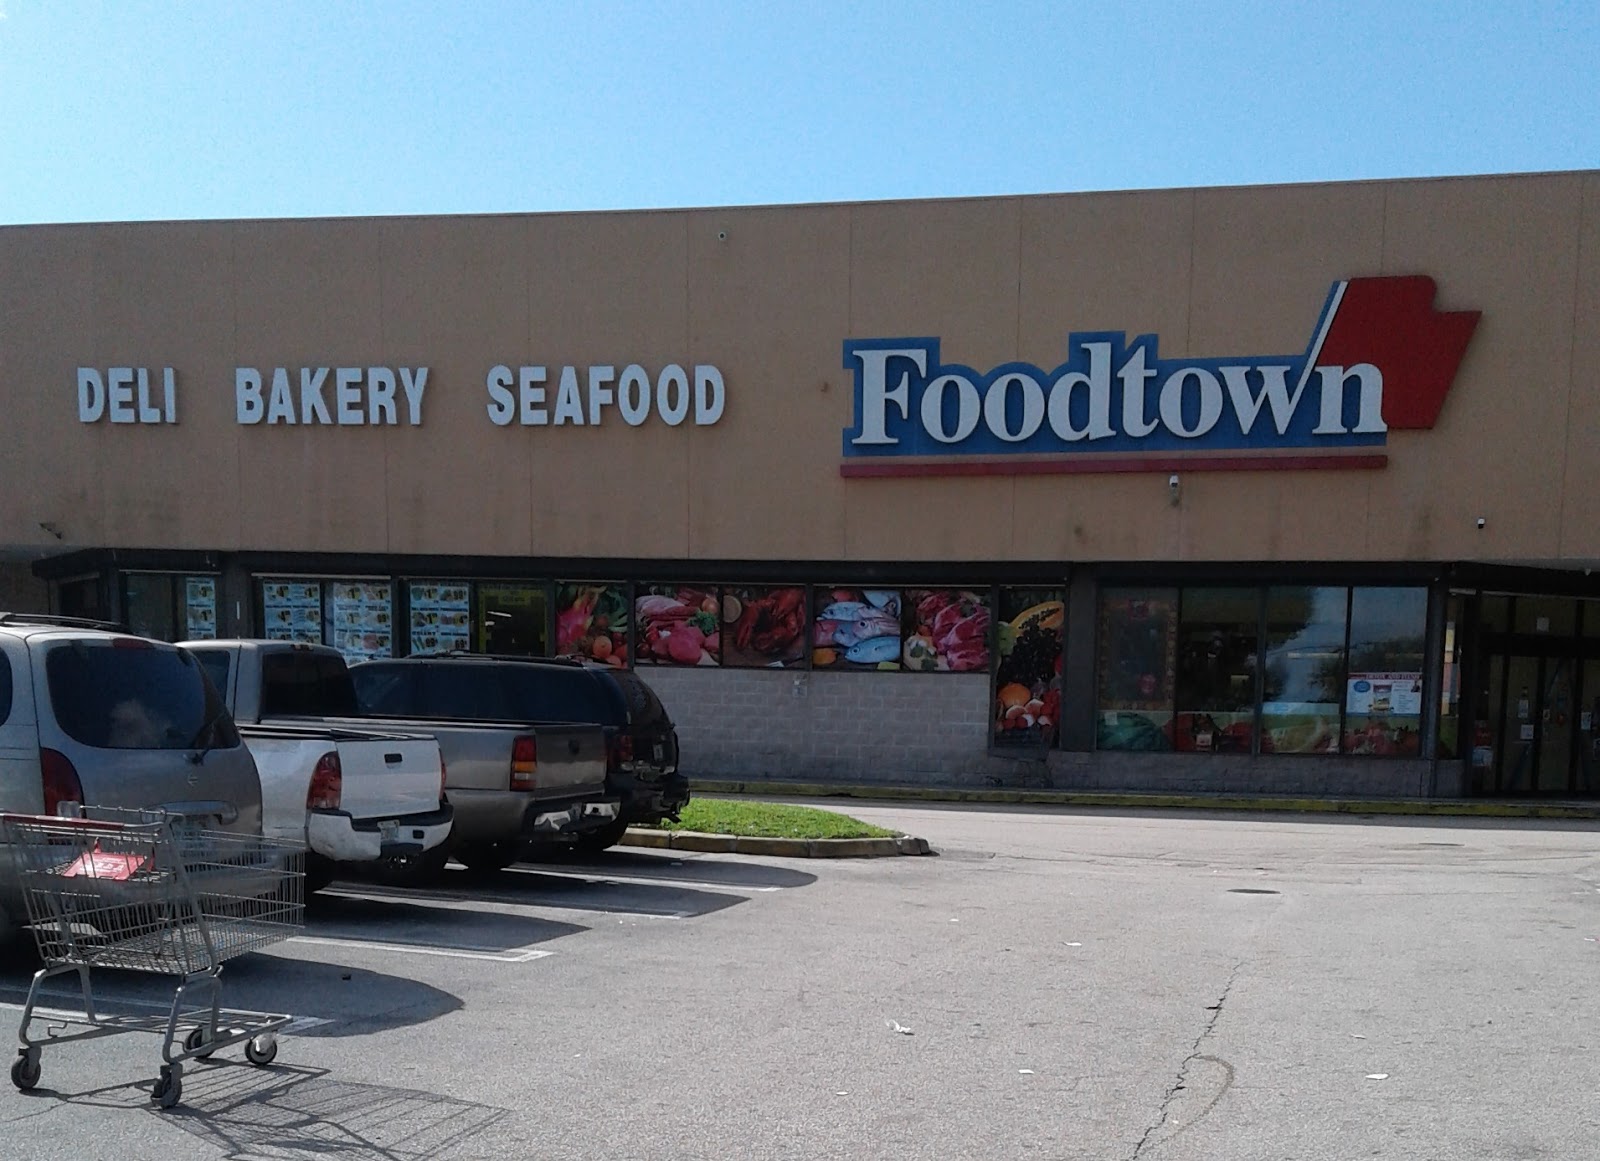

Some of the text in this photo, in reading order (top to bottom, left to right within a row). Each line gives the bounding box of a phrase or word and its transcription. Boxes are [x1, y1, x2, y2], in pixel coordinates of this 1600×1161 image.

[77, 364, 726, 426] DELI BAKERY SEAFOOD
[851, 281, 1388, 445] Foodtown
